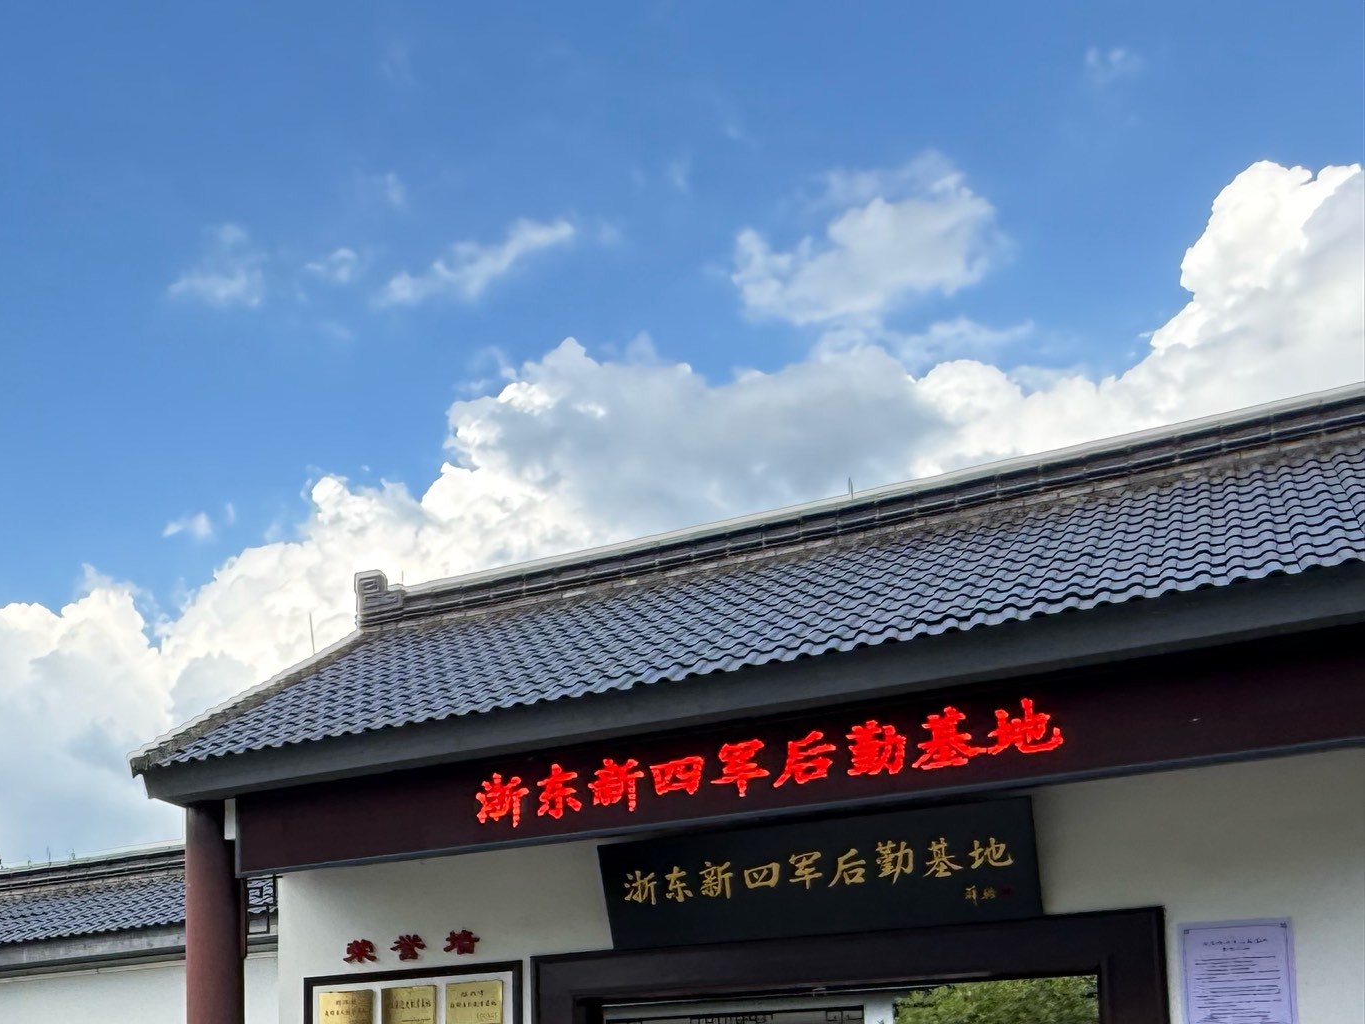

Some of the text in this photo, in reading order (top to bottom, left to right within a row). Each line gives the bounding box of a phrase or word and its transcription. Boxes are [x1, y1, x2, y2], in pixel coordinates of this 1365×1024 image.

[476, 697, 1064, 827] 浙东新四军后勤基地
[623, 837, 1014, 906] 浙东新四军后勤基地
